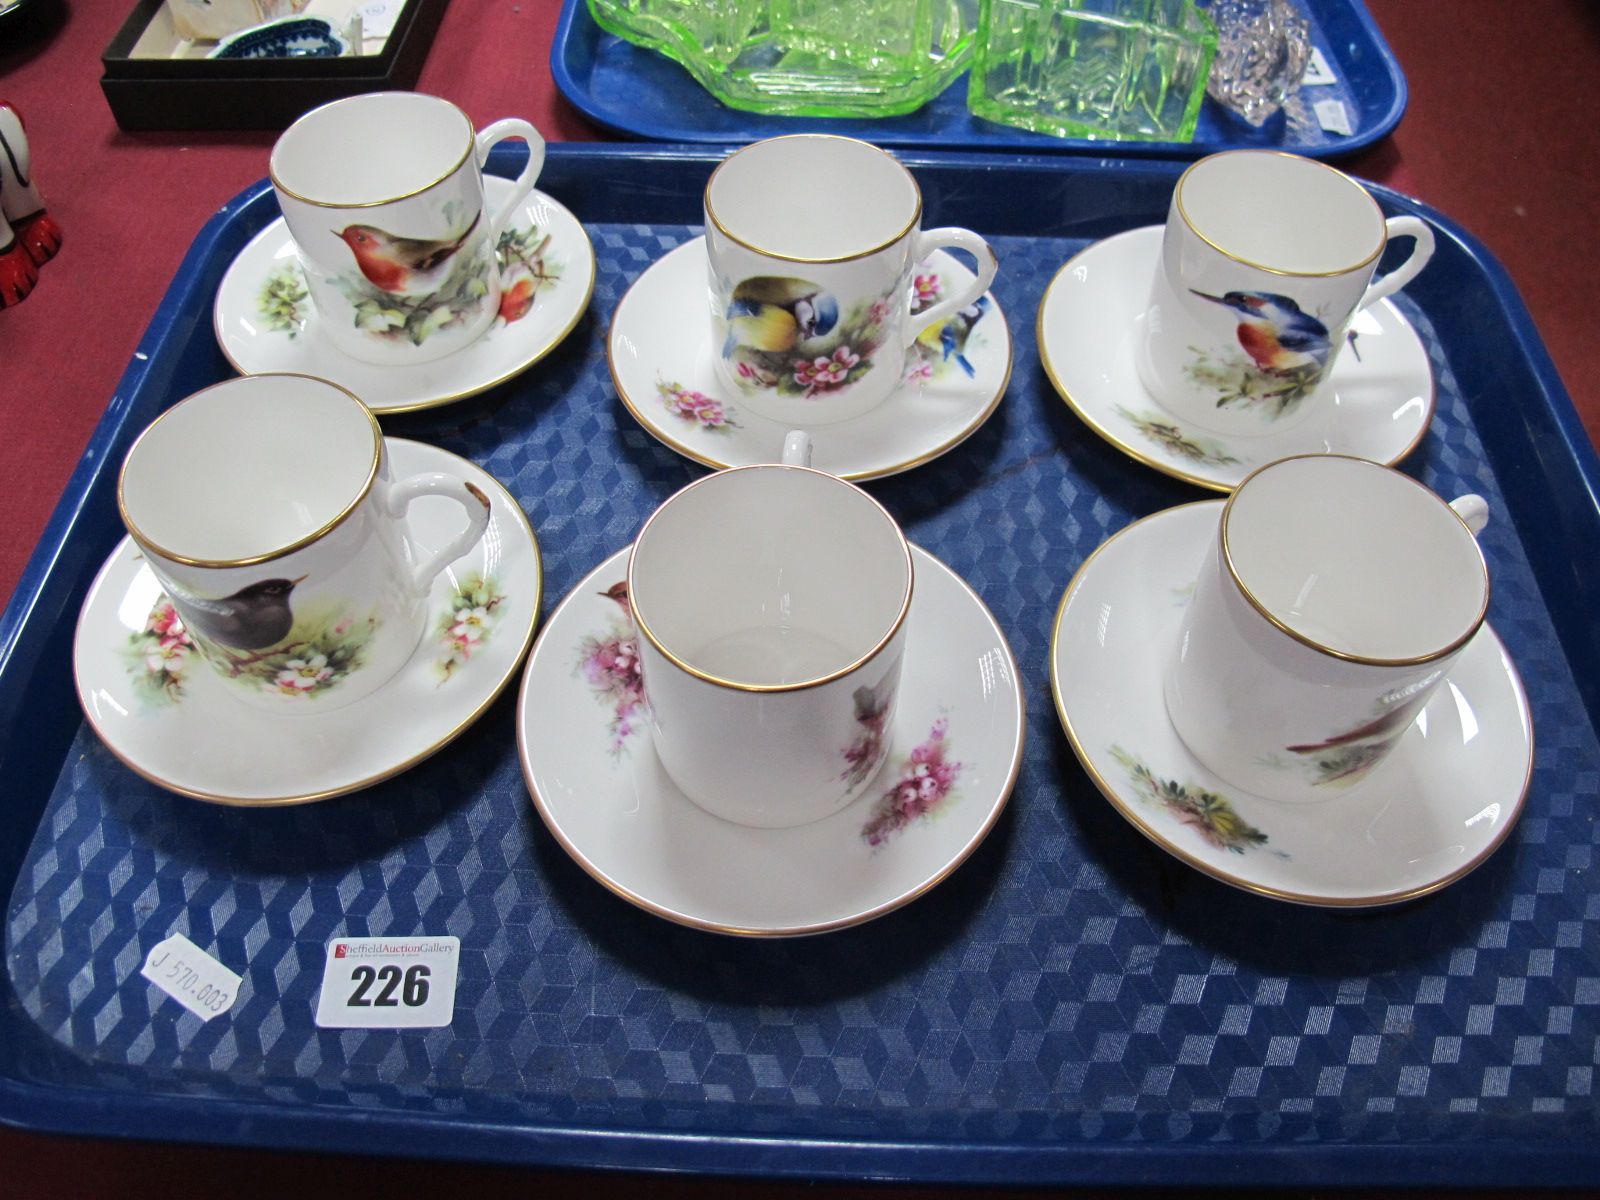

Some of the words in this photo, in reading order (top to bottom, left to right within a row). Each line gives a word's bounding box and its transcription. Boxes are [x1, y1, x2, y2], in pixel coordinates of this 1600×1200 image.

[152, 952, 170, 967] J
[166, 960, 228, 1012] 570.003
[347, 964, 431, 1007] 226
